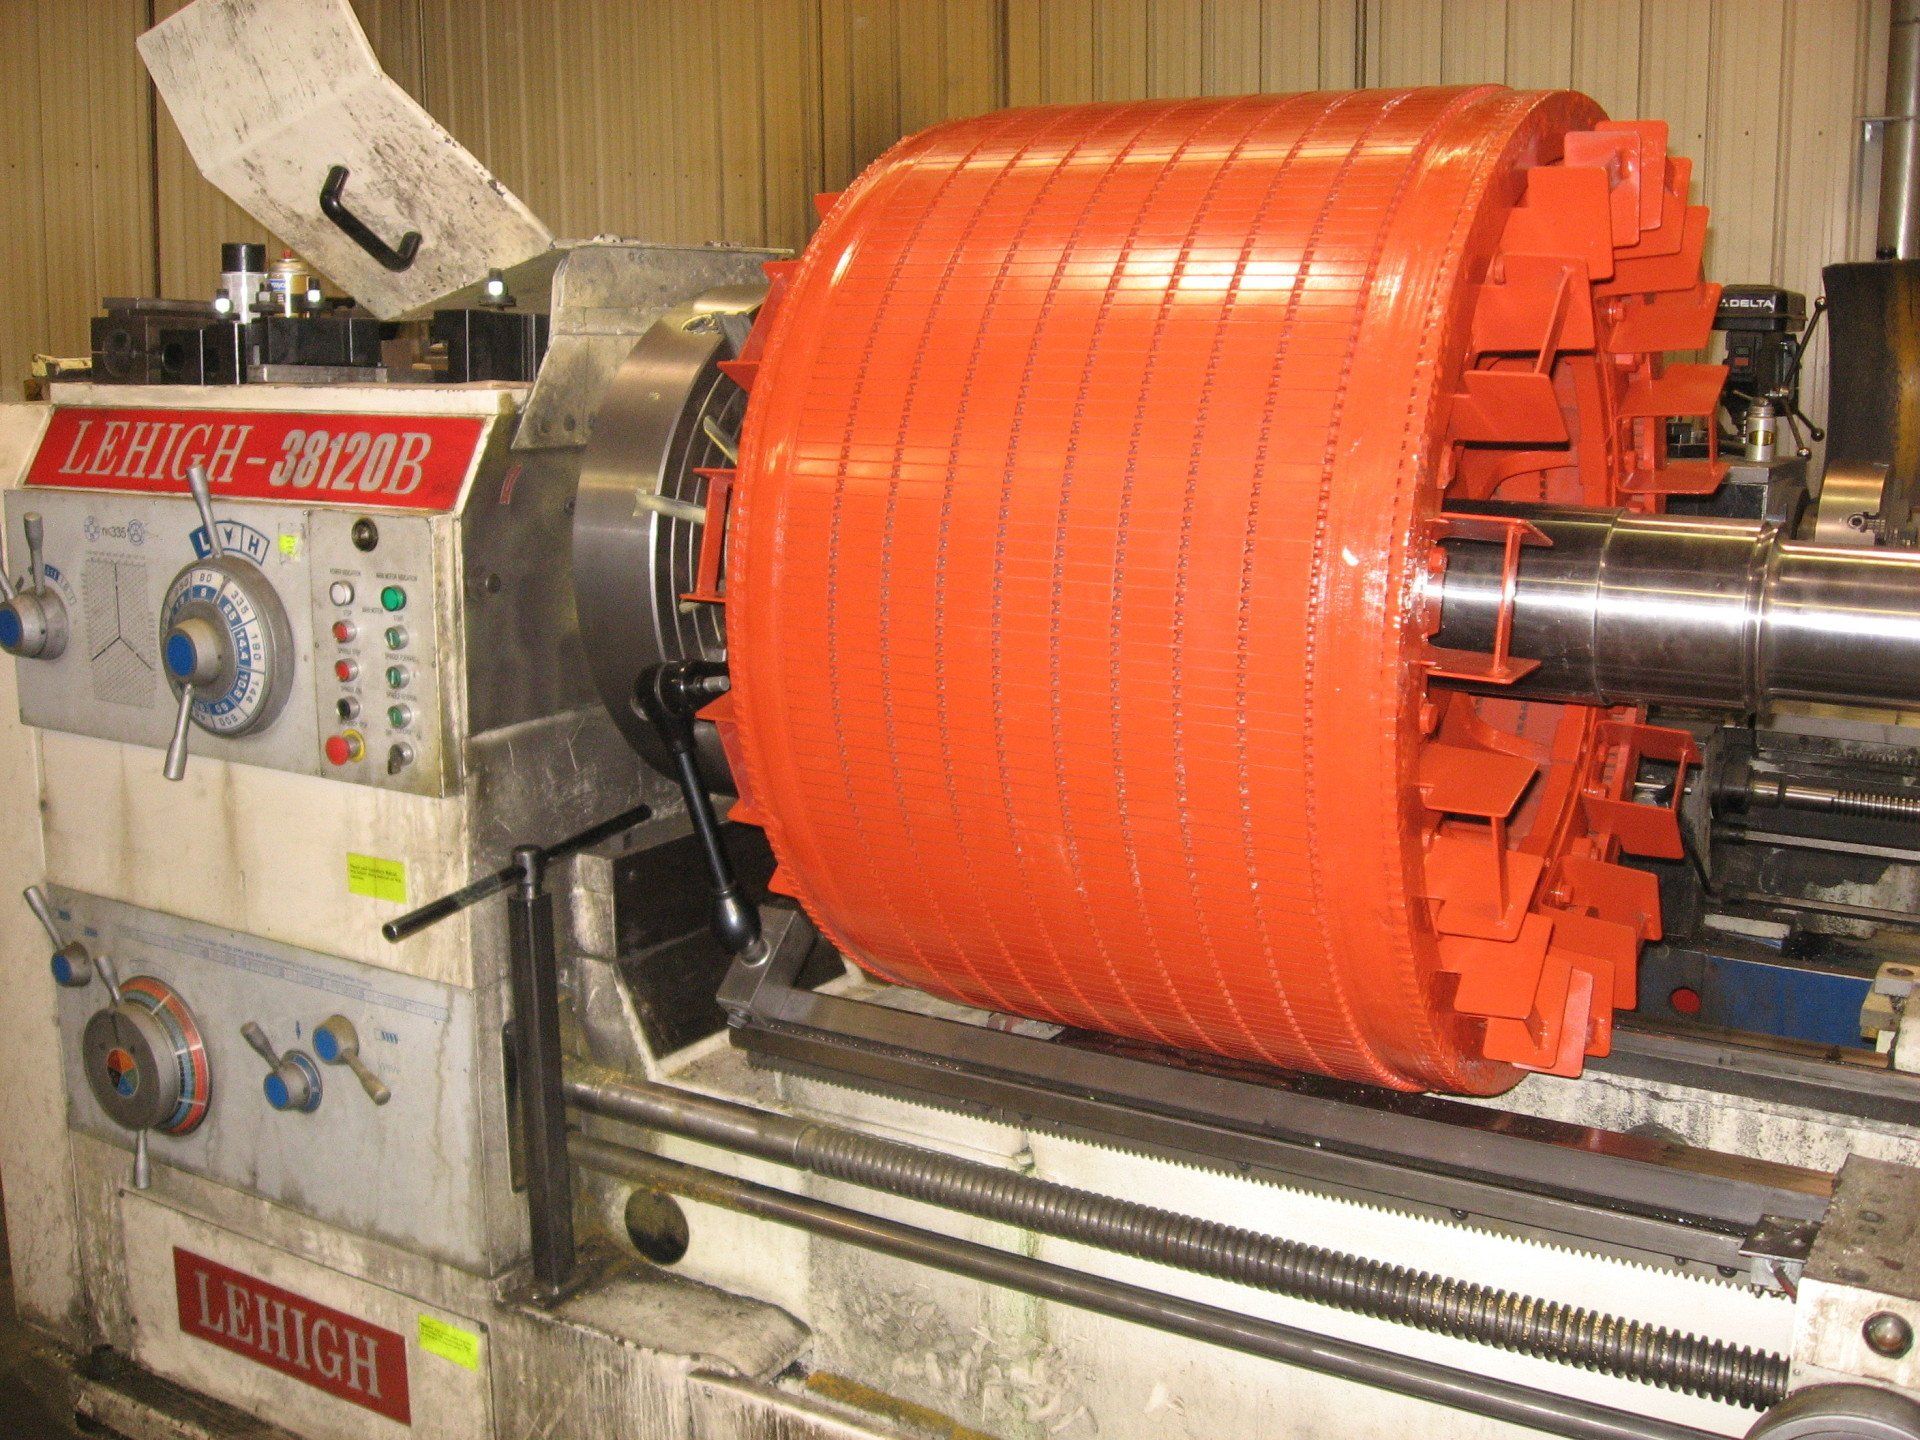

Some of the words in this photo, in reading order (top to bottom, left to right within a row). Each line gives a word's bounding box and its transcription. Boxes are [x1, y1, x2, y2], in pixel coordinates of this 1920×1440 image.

[1729, 299, 1773, 308] DELTA
[58, 420, 432, 495] LEHIGH-38120B
[248, 534, 260, 554] H
[195, 1269, 382, 1398] LEHIGH
